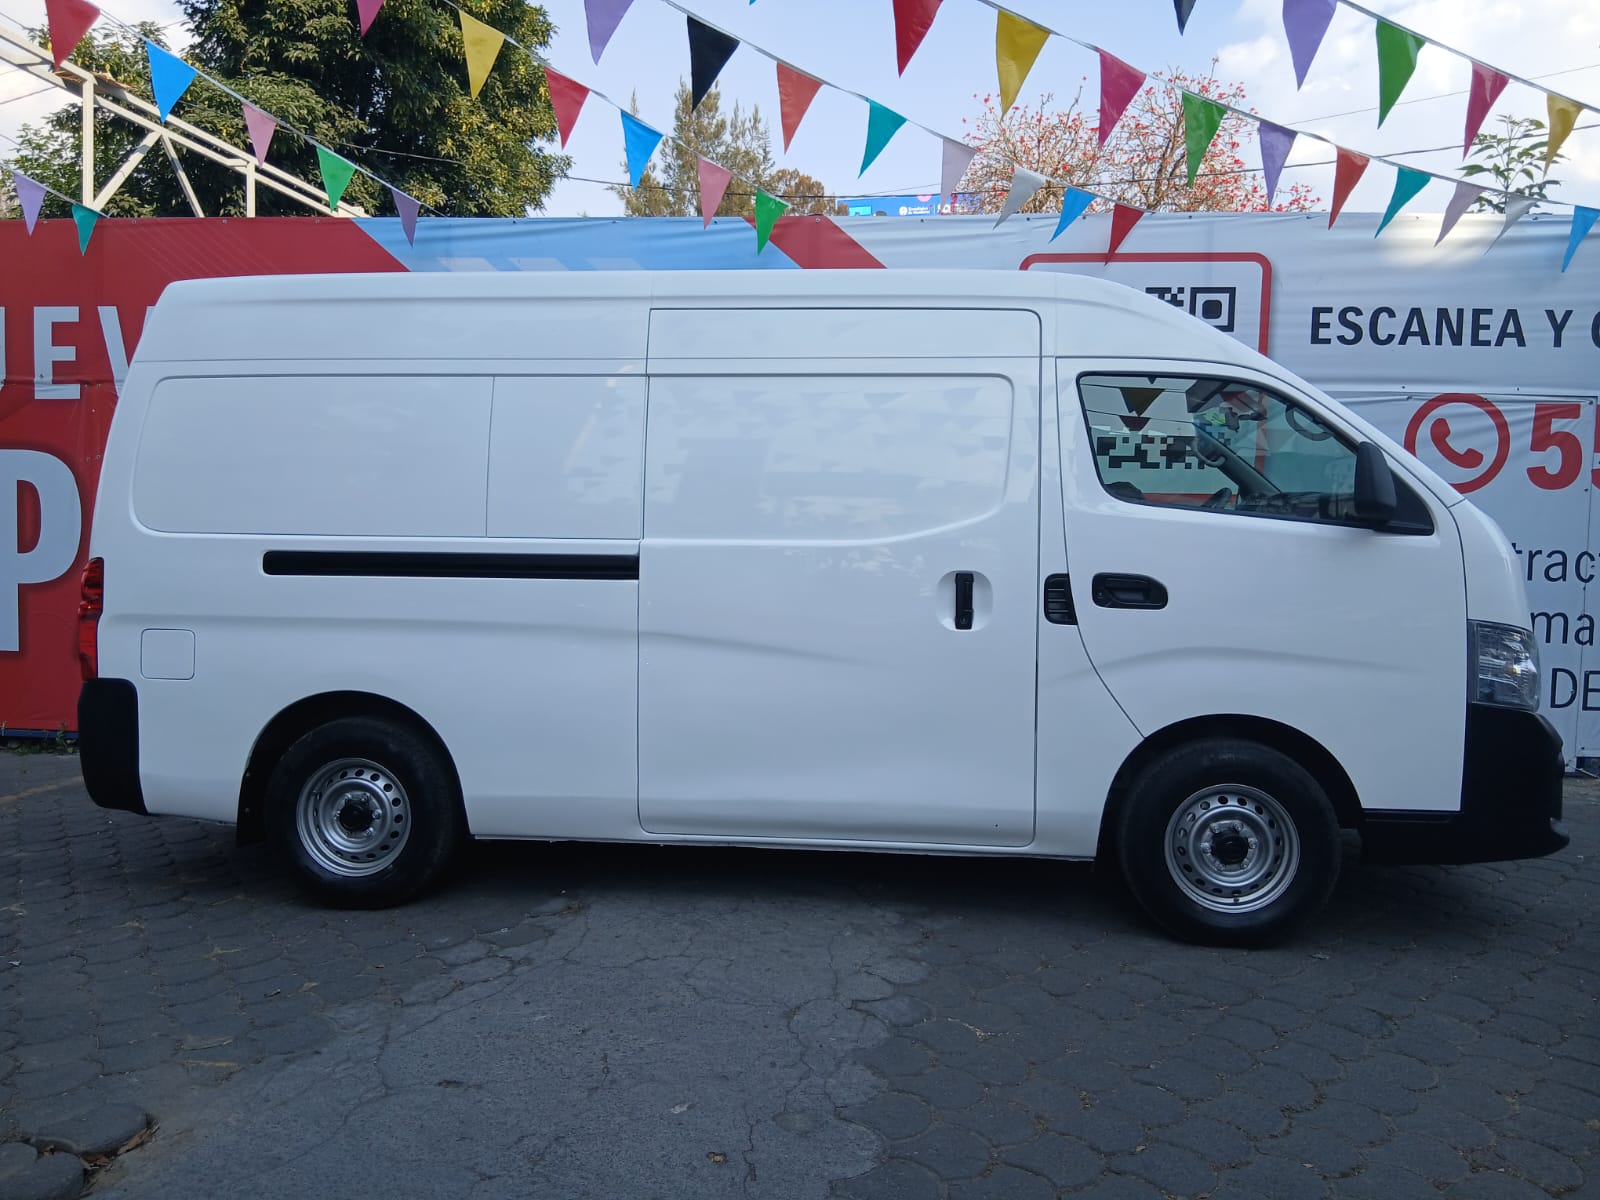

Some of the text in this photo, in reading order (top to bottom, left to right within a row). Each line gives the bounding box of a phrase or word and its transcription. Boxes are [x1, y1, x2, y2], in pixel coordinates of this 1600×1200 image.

[1310, 306, 1526, 347] ESCANEA
[1545, 310, 1573, 348] Y
[1526, 403, 1600, 490] 5
